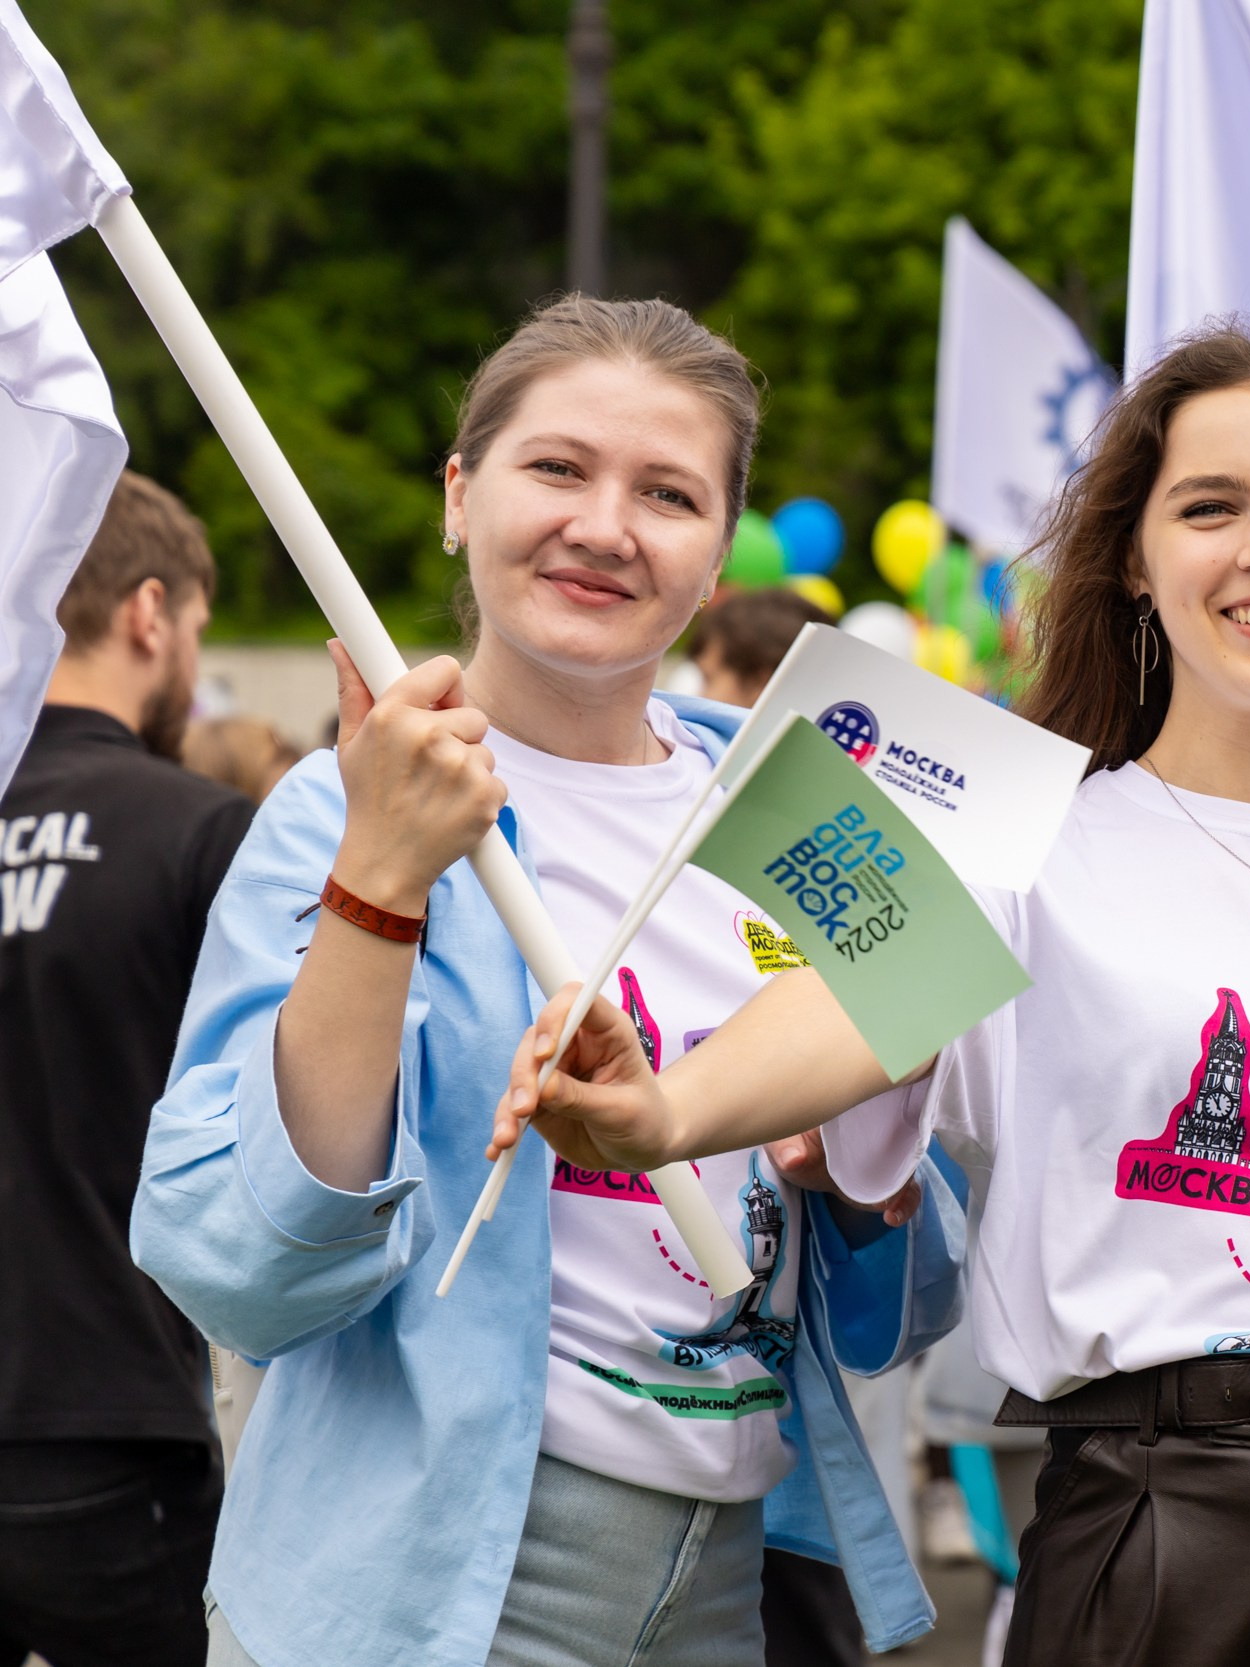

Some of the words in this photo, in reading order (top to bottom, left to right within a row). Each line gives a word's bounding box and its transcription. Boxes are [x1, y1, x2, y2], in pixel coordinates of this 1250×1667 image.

[886, 741, 965, 790] МОСКВА
[0, 811, 100, 867] CAL
[835, 904, 904, 963] 2024
